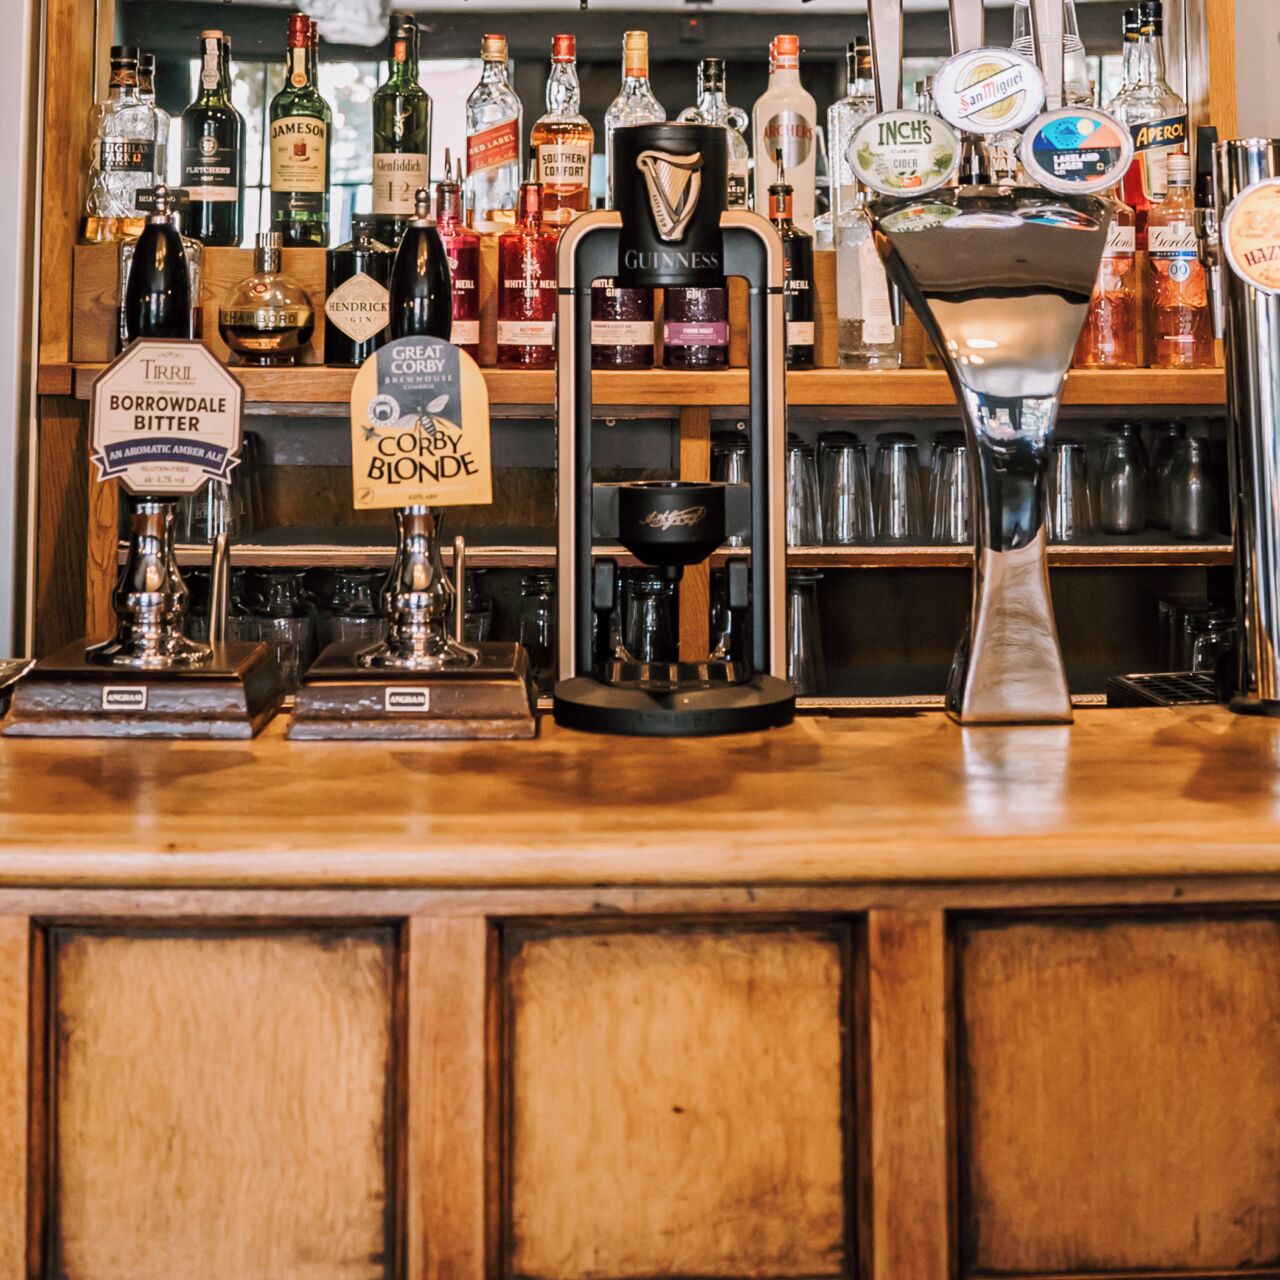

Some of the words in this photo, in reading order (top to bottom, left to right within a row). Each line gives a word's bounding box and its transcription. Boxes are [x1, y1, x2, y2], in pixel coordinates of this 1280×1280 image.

[958, 92, 984, 114] San
[982, 70, 1023, 98] Miguel
[272, 122, 324, 139] JAMESON
[764, 124, 812, 141] ARCHERS
[877, 120, 932, 146] INCH'S
[1136, 122, 1183, 147] APEROL
[469, 144, 486, 156] RED
[487, 134, 515, 149] LABEL
[102, 152, 131, 162] PARK
[132, 153, 141, 163] 12
[376, 158, 421, 172] Glenfiddich
[542, 153, 586, 165] SOUTHERN
[893, 159, 918, 168] CIDER
[1053, 153, 1099, 162] LAKELAND
[1054, 162, 1083, 171] LAGER
[388, 181, 410, 202] 12
[1152, 231, 1198, 248] Gordon
[625, 250, 719, 269] GUINNESS
[456, 280, 475, 289] NEILL
[504, 280, 537, 289] WHITLEY
[790, 280, 809, 289] NEILL
[524, 289, 539, 297] GIN
[686, 291, 702, 299] GIN
[329, 302, 389, 312] HENDRICK'
[224, 311, 296, 324] CHAMBORD
[392, 345, 443, 359] GREAT
[140, 359, 197, 381] TIRRIL
[391, 359, 446, 374] CORBY
[385, 374, 453, 384] BREWHOUSE
[110, 395, 226, 413] BORROWDALE
[134, 415, 200, 431] BITTER
[377, 430, 463, 457] CORBY
[109, 450, 122, 461] AN
[124, 444, 170, 458] AROMATIC
[172, 445, 204, 457] AMBER
[206, 450, 223, 462] ALE
[367, 452, 479, 484] BLONDE
